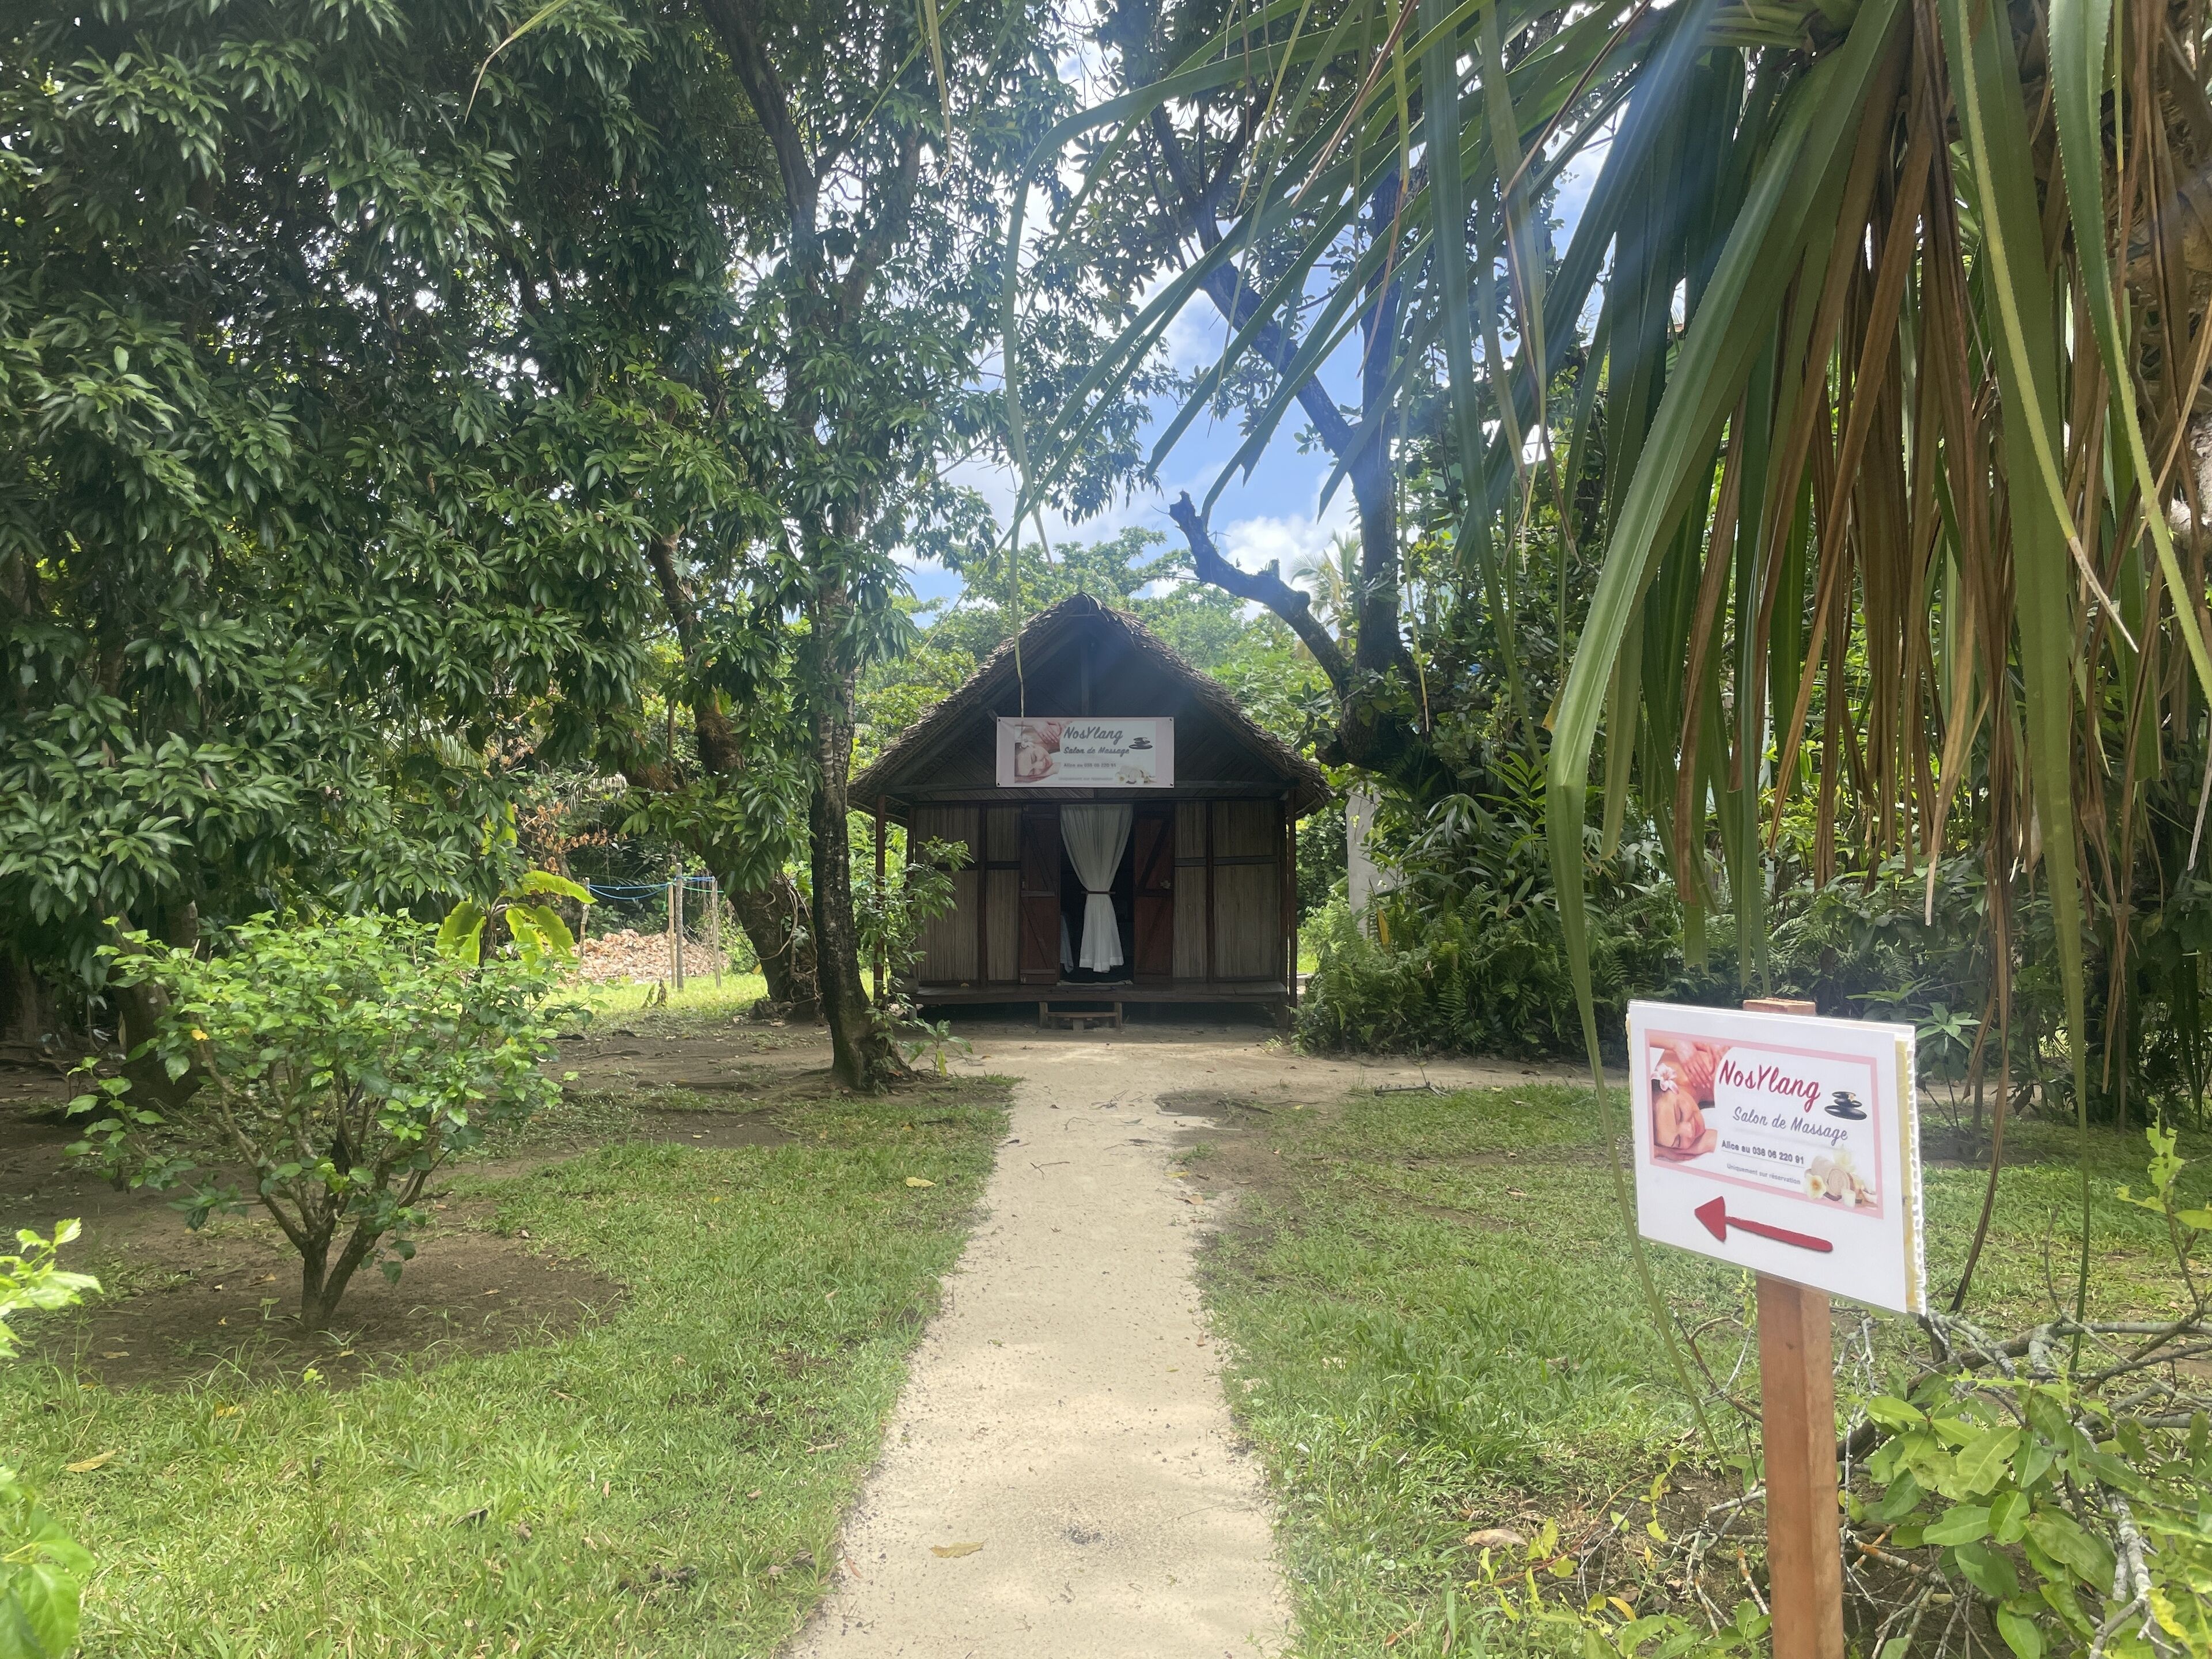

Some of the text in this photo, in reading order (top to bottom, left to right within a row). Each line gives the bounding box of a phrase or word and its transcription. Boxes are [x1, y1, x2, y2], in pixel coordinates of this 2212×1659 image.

[1063, 726, 1123, 745] NosYlang
[1098, 747, 1130, 757] Massage
[1719, 1059, 1820, 1112] NosYlang
[1733, 1106, 1848, 1146] Salon de Massage
[1722, 1140, 1804, 1164] Alice au 038 06 220 91
[1726, 1163, 1758, 1175] Uniquement
[1769, 1173, 1801, 1184] réservation
